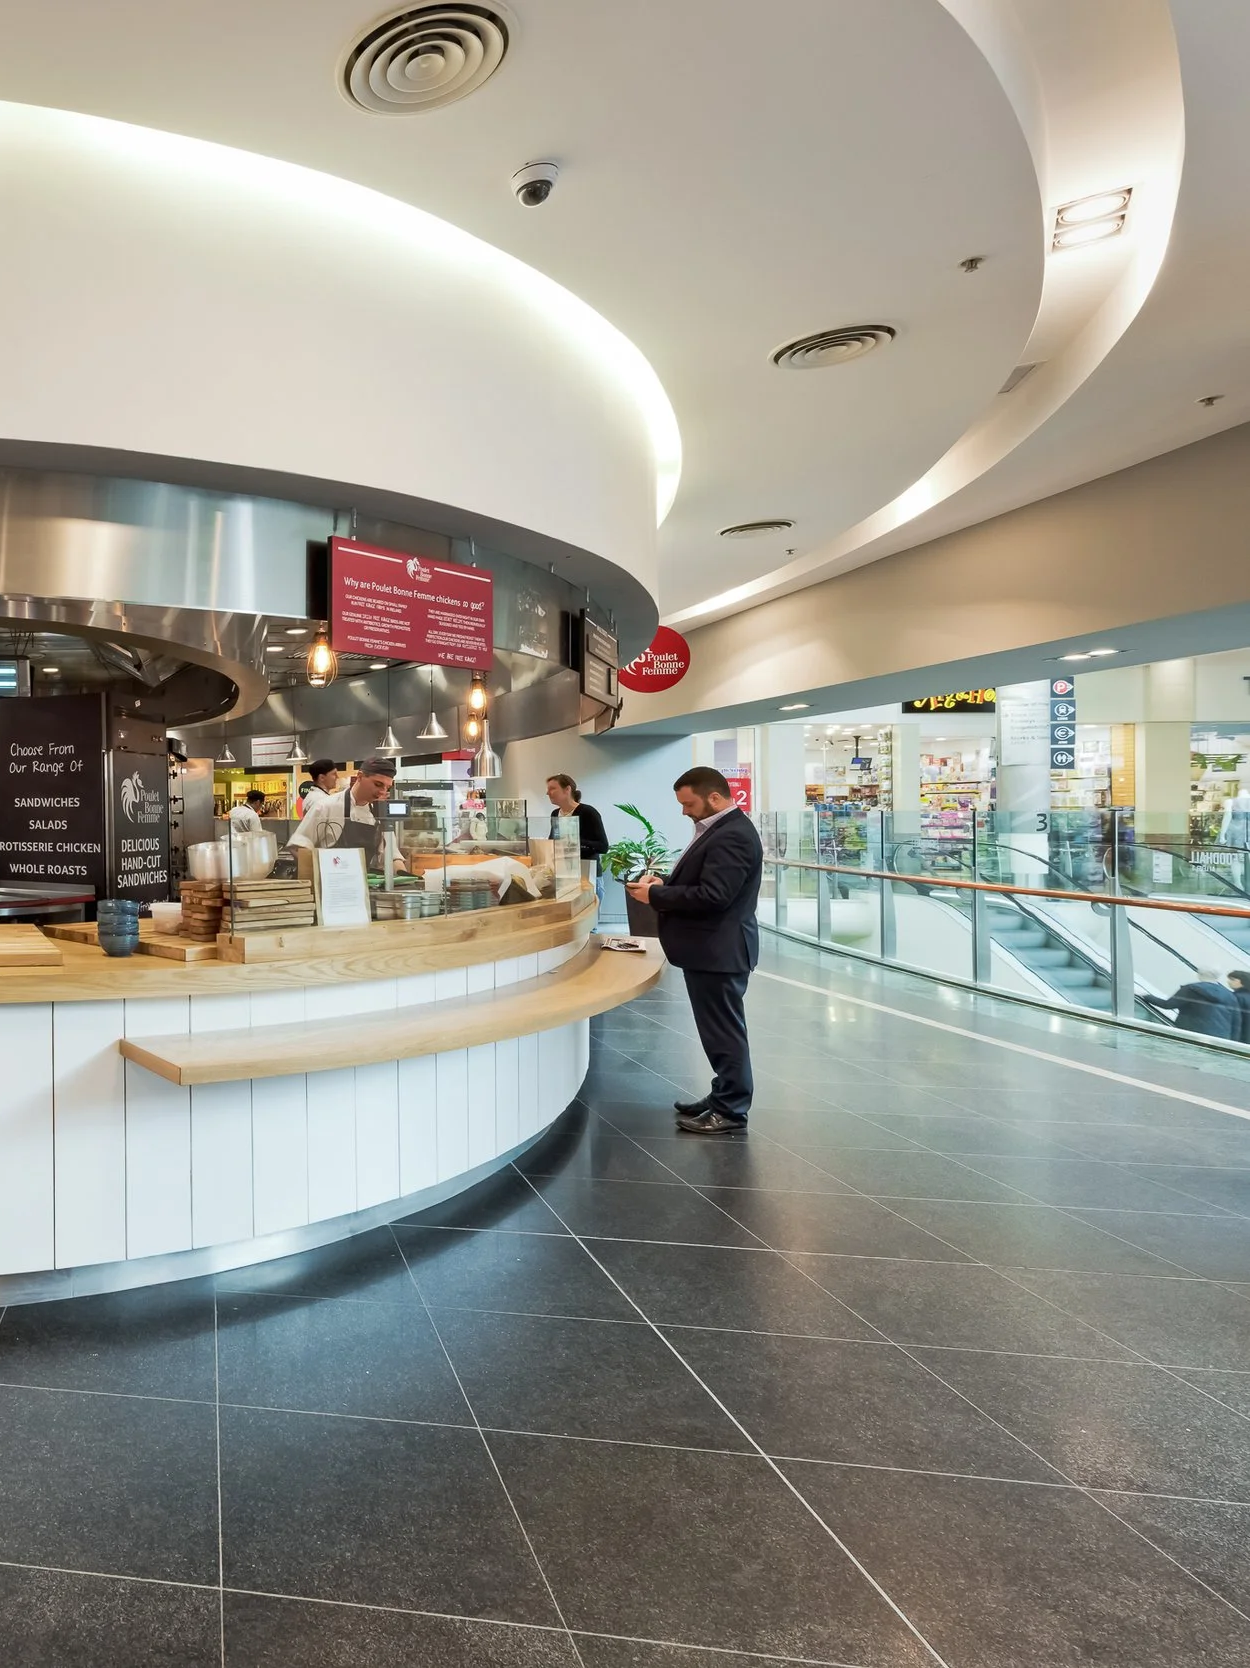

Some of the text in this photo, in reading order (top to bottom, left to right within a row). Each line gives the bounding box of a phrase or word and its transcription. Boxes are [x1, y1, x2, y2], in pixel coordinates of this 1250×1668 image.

[344, 577, 359, 589] Why
[360, 582, 370, 591] are
[372, 580, 392, 594] Poulet
[393, 586, 413, 598] Bonne
[414, 589, 435, 602] Femme
[436, 594, 461, 607] chickens
[647, 653, 678, 662] Poulet
[653, 661, 685, 669] Bonne
[642, 667, 678, 676] Femme
[10, 743, 75, 757] Choose From
[9, 759, 84, 776] Our Range Of
[140, 790, 160, 802] Poulet
[14, 797, 80, 808] SANDWICHES
[144, 802, 164, 814] Bonne
[29, 819, 68, 830] SALADS
[137, 813, 161, 824] Femme
[1036, 813, 1048, 832] 3
[0, 841, 101, 853] ROTISSERIE CHICKEN
[121, 838, 160, 853] DELICIOUS
[121, 855, 162, 871] HAND-CUT
[9, 863, 88, 876] WHOLE ROASTS
[117, 870, 168, 889] SANDWICHES
